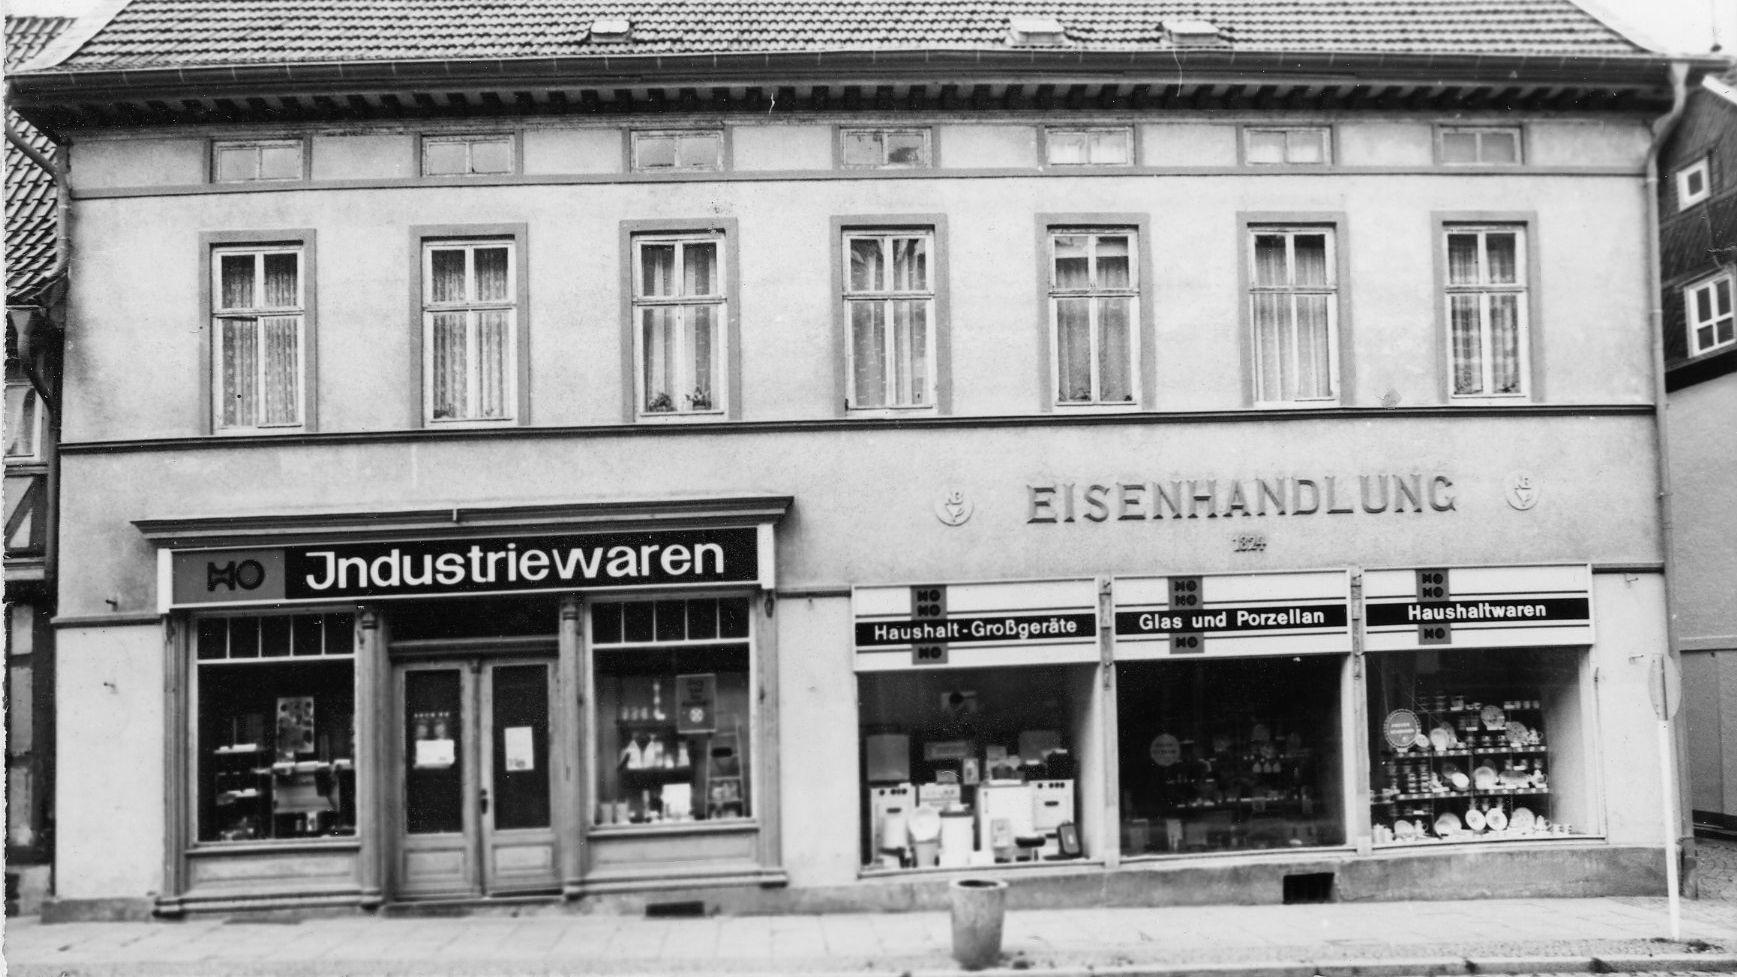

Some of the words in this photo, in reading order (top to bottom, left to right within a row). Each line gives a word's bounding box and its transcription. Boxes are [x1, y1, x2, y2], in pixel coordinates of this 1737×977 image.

[1027, 475, 1458, 524] EISENHANDLUNG
[207, 558, 265, 592] HO
[1139, 613, 1183, 631] Glas
[1192, 611, 1227, 628] und
[1237, 609, 1325, 627] Porzellan
[1408, 602, 1547, 621] Haushaltwaren
[874, 618, 1078, 640] Haushalt-Großgeräte
